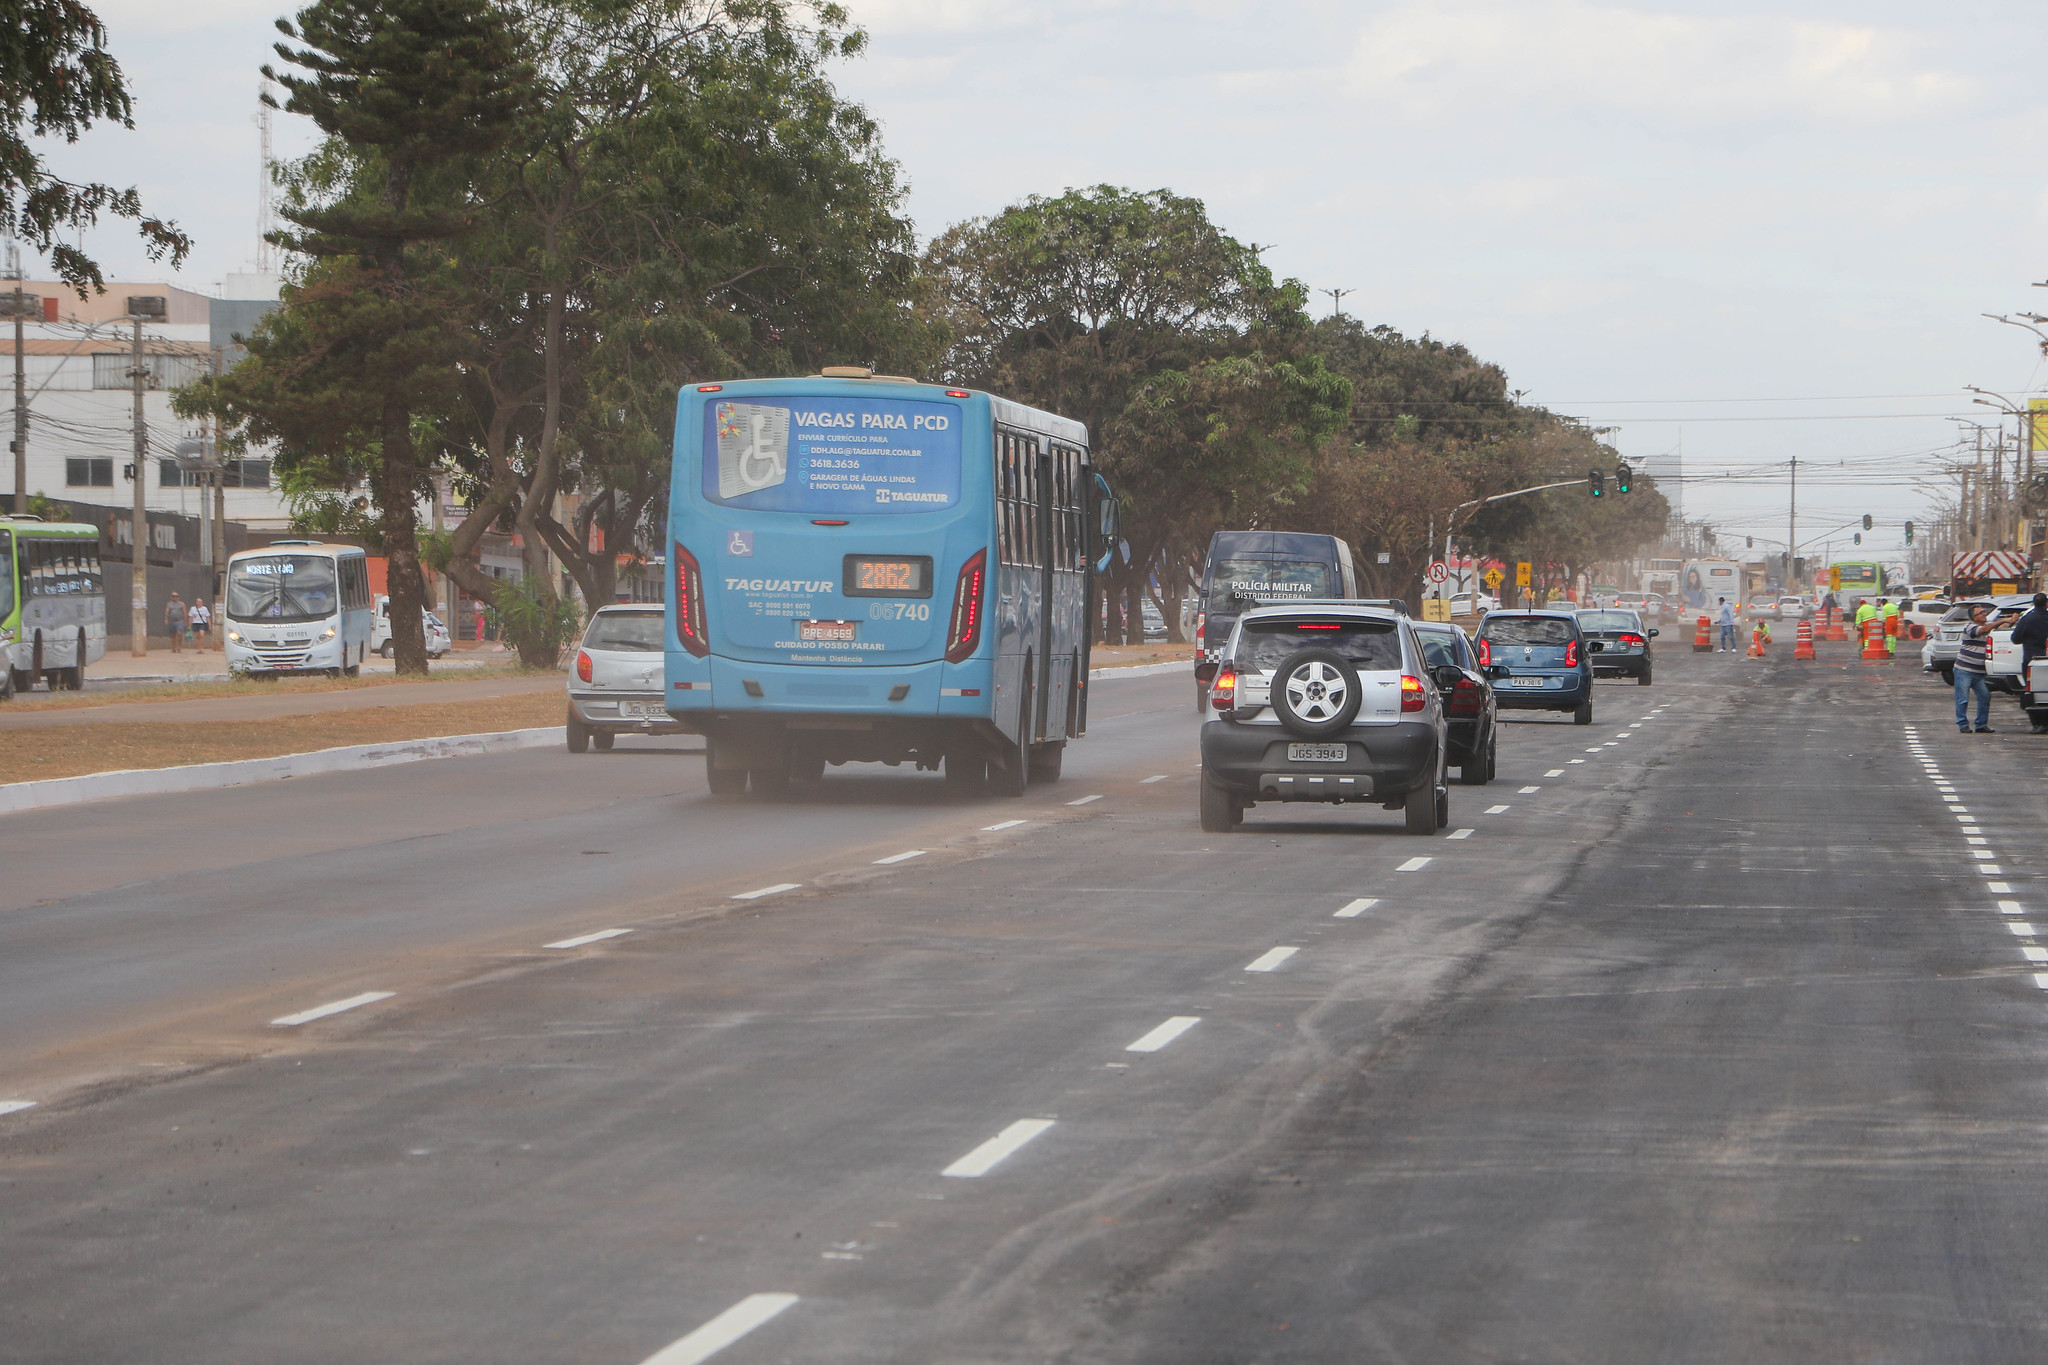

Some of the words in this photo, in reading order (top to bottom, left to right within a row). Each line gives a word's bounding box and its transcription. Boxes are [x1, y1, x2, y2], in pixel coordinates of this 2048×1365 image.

[794, 412, 855, 428] VAGAS
[861, 413, 908, 430] PARA
[913, 415, 949, 431] PCD
[827, 433, 867, 443] CURRÍCULO
[810, 459, 860, 469] 3618.3636
[810, 473, 848, 481] GARAGEM
[850, 474, 860, 482] DE
[861, 473, 887, 482] ÁGUAS
[889, 475, 915, 483] LINDAS
[842, 483, 866, 491] GAMA
[891, 492, 948, 502] TAGUATUR
[116, 519, 151, 547] POLA
[861, 563, 911, 589] 2862
[725, 578, 834, 593] TAGUATUR
[1231, 580, 1270, 591] POLÍCIA
[1272, 582, 1312, 592] MILITAR
[1234, 591, 1271, 599] DISTRITO
[869, 602, 930, 621] 06740
[774, 641, 816, 649] CUIDADO
[818, 642, 849, 650] POSSO
[851, 643, 885, 651] PARAR!
[791, 654, 826, 662] Mantenha
[830, 655, 863, 663] Distância
